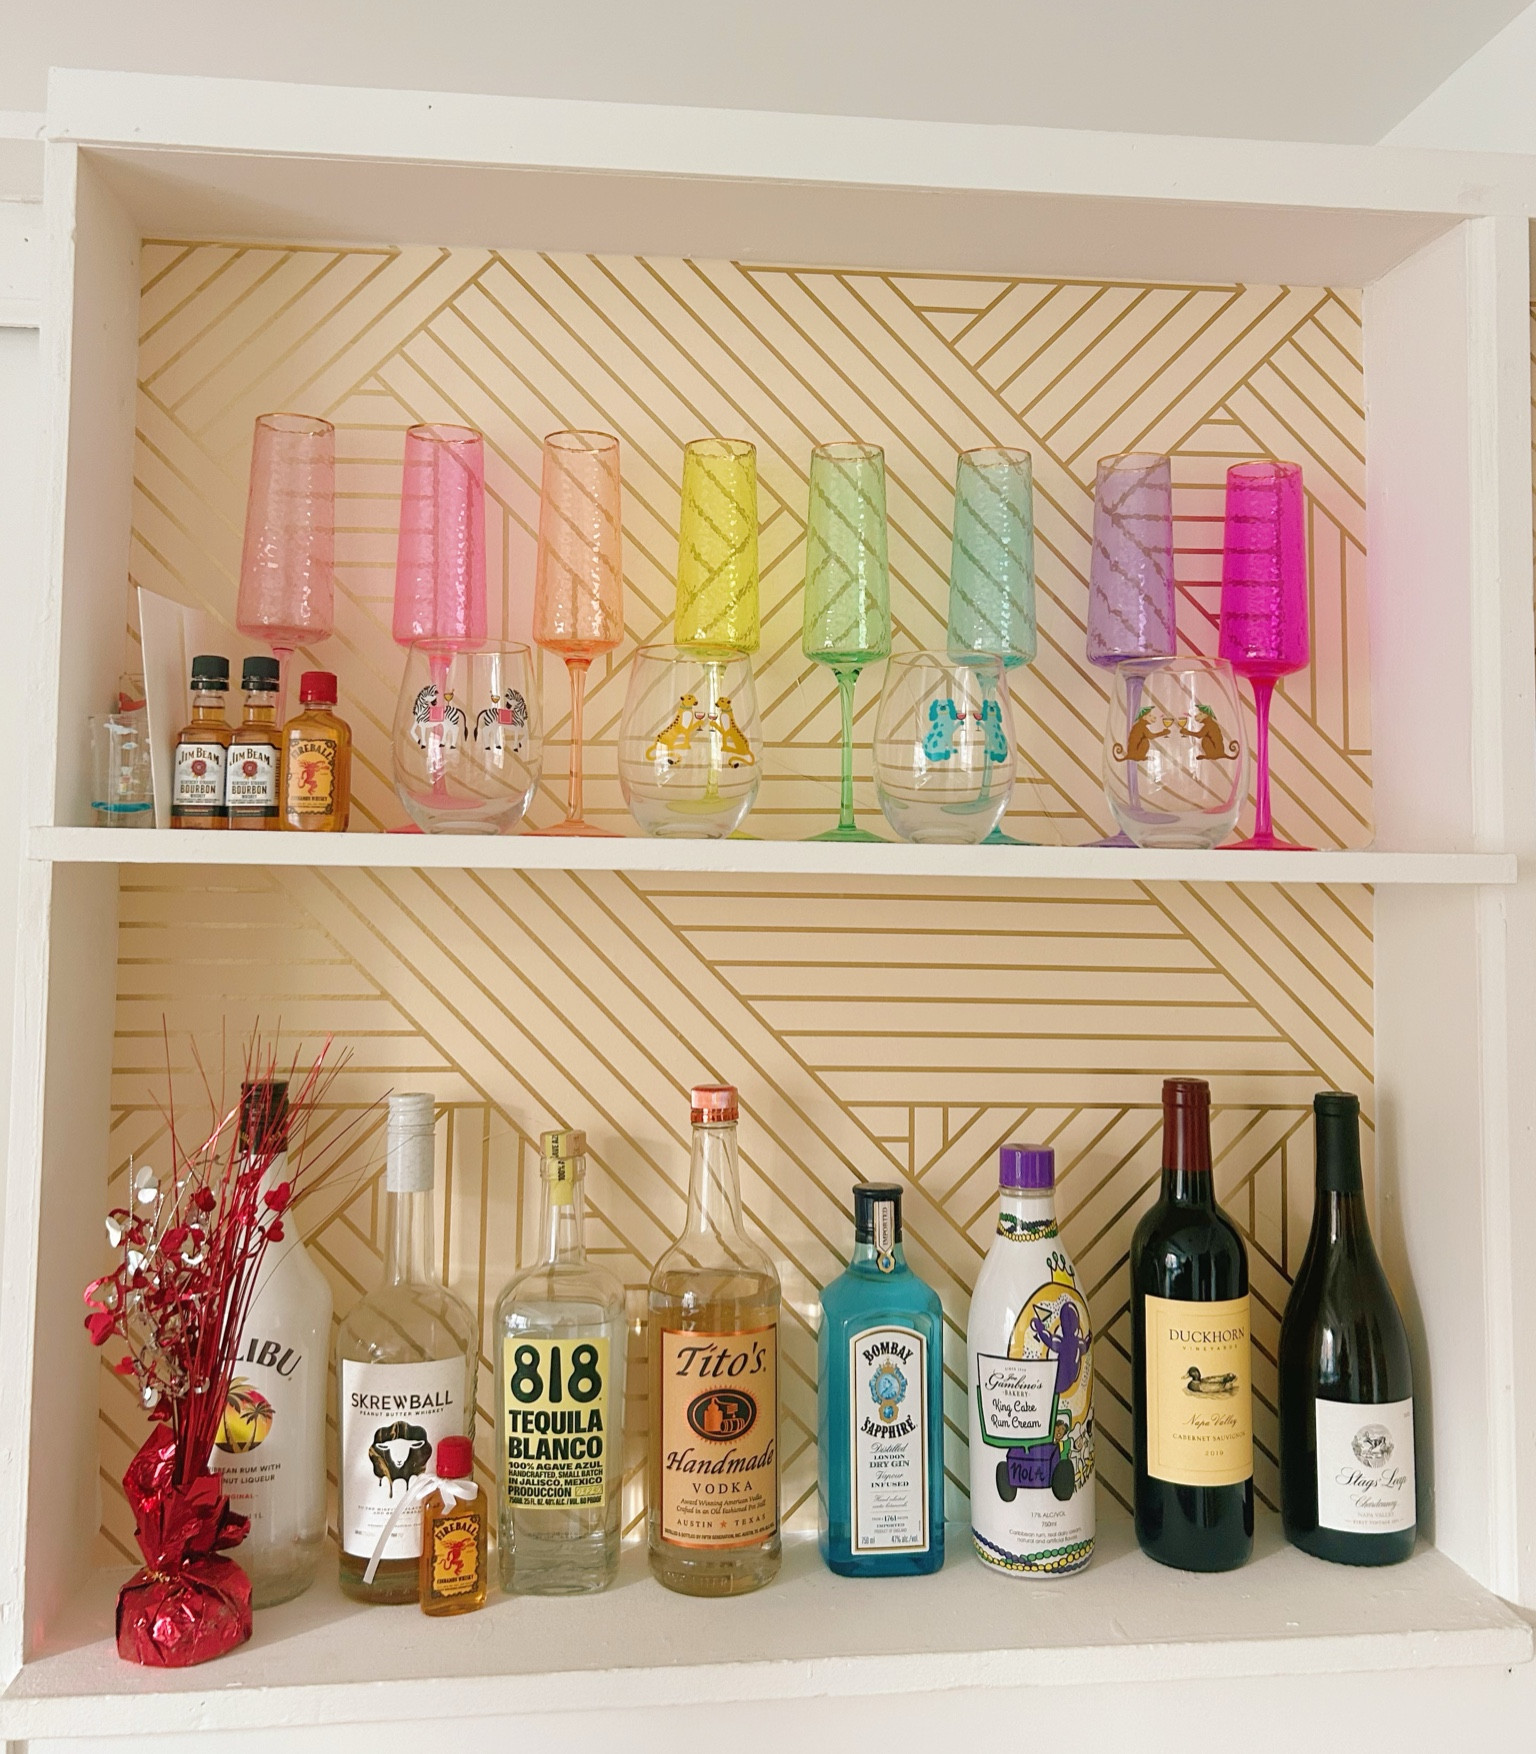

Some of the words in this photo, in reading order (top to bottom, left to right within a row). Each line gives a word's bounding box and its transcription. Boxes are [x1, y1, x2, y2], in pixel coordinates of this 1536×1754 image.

[178, 750, 194, 765] JIM
[196, 747, 220, 765] BEAM
[229, 752, 245, 766] JIM
[247, 748, 270, 766] BEAM
[180, 784, 216, 794] BOURBON
[232, 786, 267, 794] BOURBON
[1169, 1327, 1244, 1342] DUCKHORN
[862, 1342, 913, 1366] BOMBAY
[510, 1344, 602, 1403] 818
[985, 1369, 1042, 1390] Gambino's
[352, 1390, 453, 1410] SKREWBALL
[992, 1398, 1012, 1417] King
[1014, 1400, 1037, 1412] Cake
[508, 1409, 603, 1435] TEQUILA
[861, 1414, 916, 1439] SAPPHIRE
[991, 1414, 1010, 1428] Rum
[1012, 1416, 1041, 1429] Cream
[1182, 1414, 1210, 1429] Napa
[1211, 1413, 1237, 1428] Valley
[1173, 1433, 1210, 1441] CABERNET
[508, 1436, 603, 1460] BLANCO
[871, 1442, 908, 1454] Distilled
[666, 1439, 774, 1474] Handmade
[260, 1463, 280, 1472] WITH
[508, 1462, 534, 1470] 100%
[575, 1461, 603, 1469] AZUL
[241, 1475, 275, 1484] LIQUEUR
[508, 1470, 557, 1479] HANDCRAFTED,
[558, 1470, 580, 1478] SMALL
[508, 1477, 518, 1485] IN
[519, 1479, 563, 1487] JALISCO,
[564, 1477, 602, 1485] MEXICO
[693, 1480, 752, 1494] VODKA
[677, 1505, 694, 1514] Crafted
[722, 1505, 747, 1514] Fashioned
[700, 1499, 723, 1508] Winning
[724, 1498, 748, 1506] American
[677, 1519, 712, 1528] AUSTIN
[735, 1513, 766, 1526] TEXAS
[435, 1522, 477, 1541] FIREBALL
